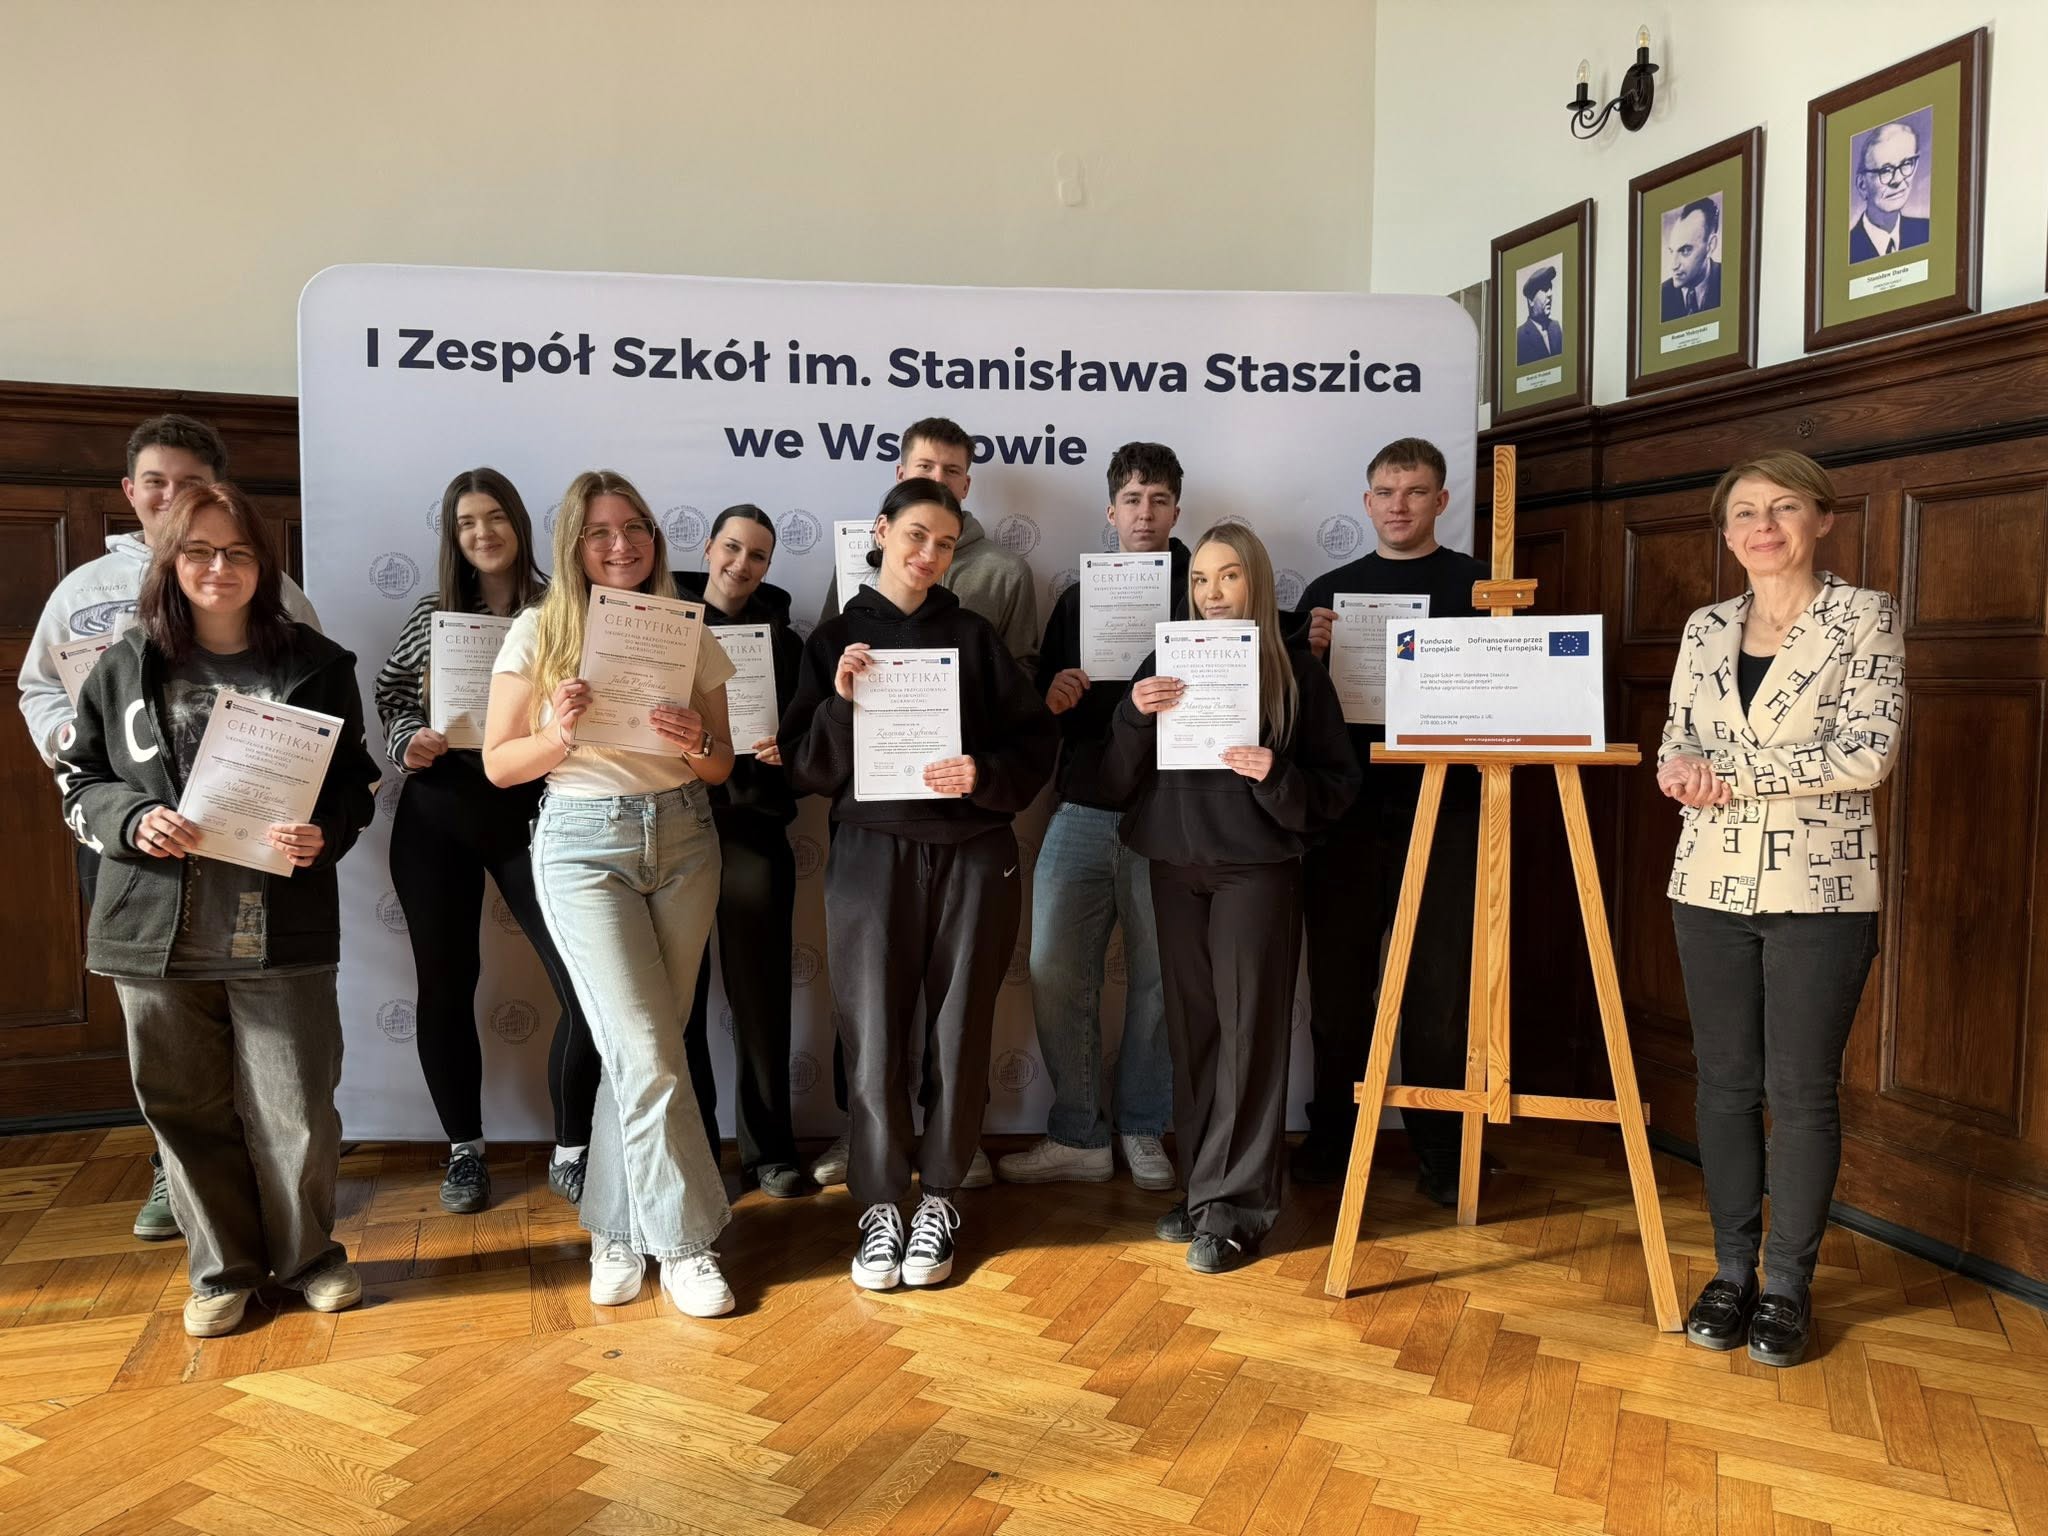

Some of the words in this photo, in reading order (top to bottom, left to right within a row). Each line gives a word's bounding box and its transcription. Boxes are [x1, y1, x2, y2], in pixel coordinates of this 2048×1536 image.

[367, 327, 379, 368] I
[399, 329, 596, 383] Zespół
[612, 335, 771, 384] Szkół
[788, 339, 871, 387] im.
[887, 346, 1188, 393] Stanisława
[1203, 352, 1421, 393] Staszica
[723, 427, 804, 459] we
[817, 422, 1088, 466] Wsowie
[1093, 573, 1161, 583] CERTYFIKAT
[605, 613, 692, 637] CERTYFIKAT
[1467, 637, 1522, 645] Dofinansowane
[1523, 637, 1543, 645] przez
[1171, 648, 1250, 660] CERTYFIKAT
[1486, 645, 1502, 653] Unię
[1504, 645, 1543, 653] Europejską
[868, 672, 950, 684] CERTYFIKAT
[227, 719, 322, 753] CERTYFIKAT
